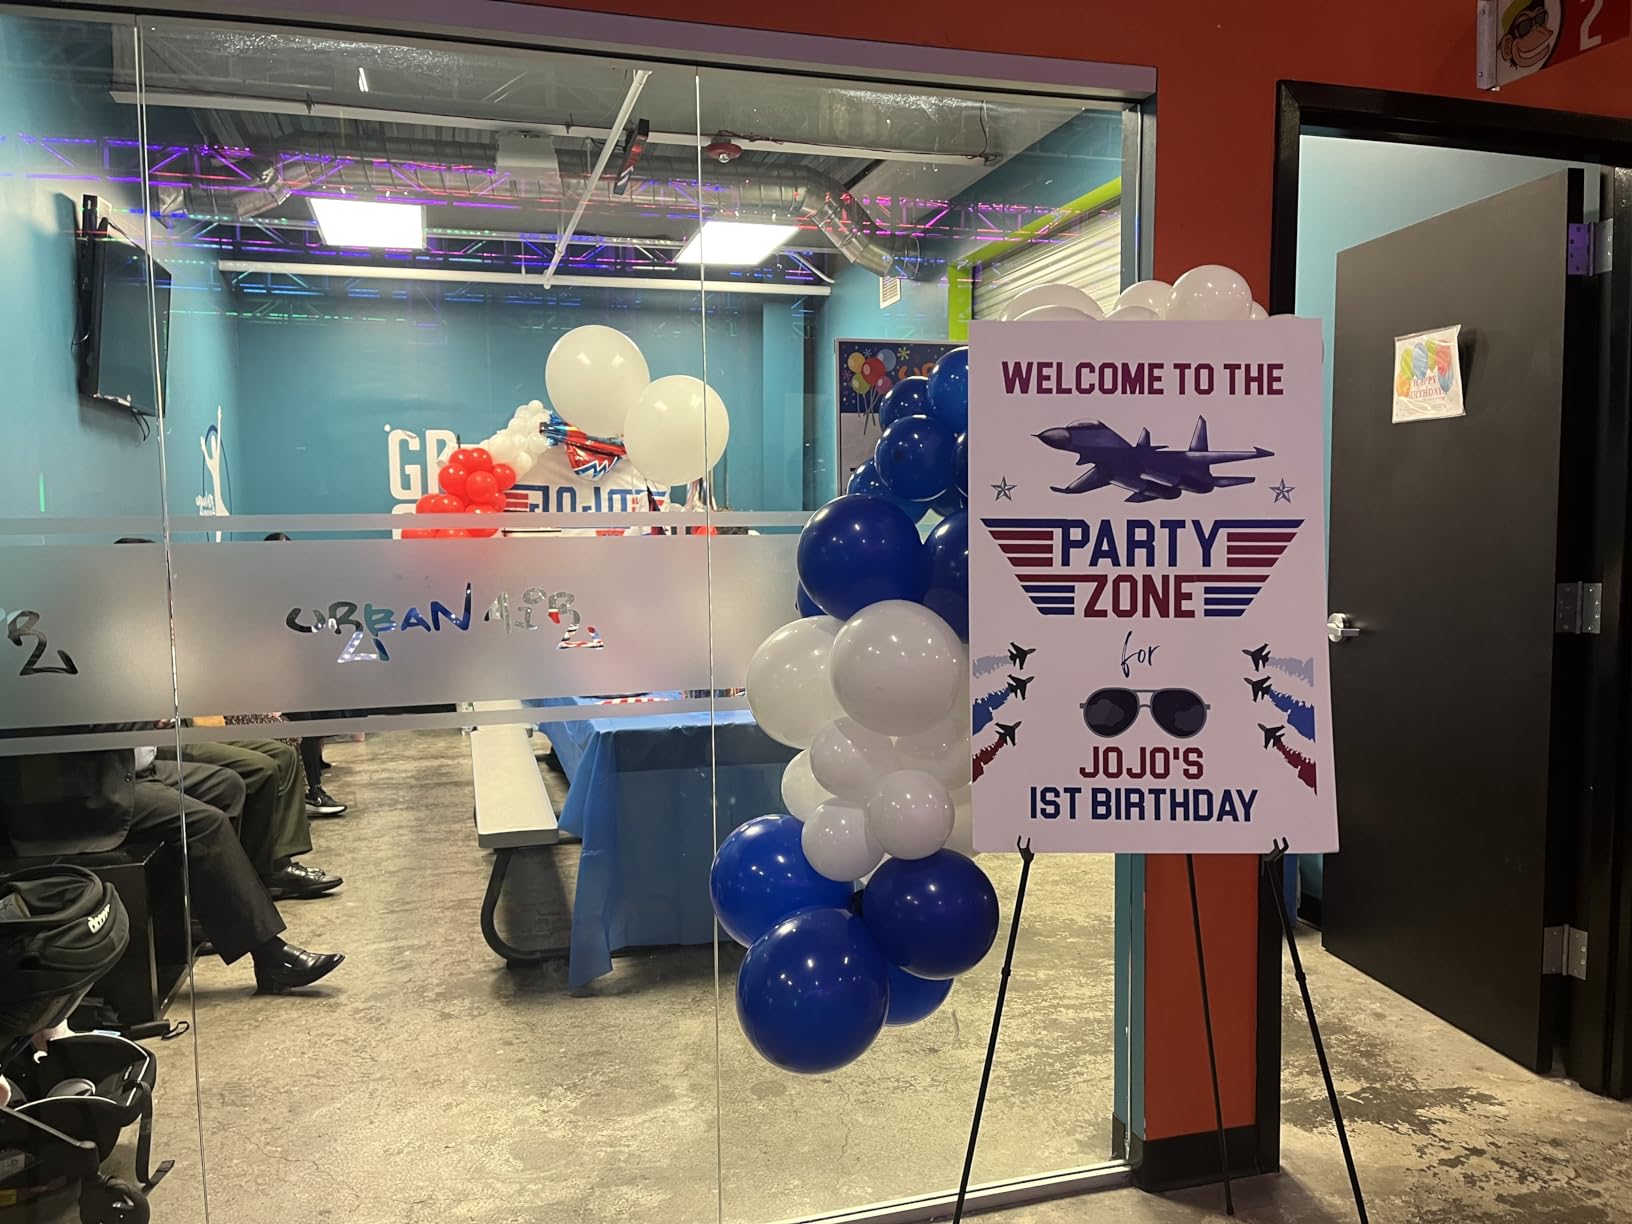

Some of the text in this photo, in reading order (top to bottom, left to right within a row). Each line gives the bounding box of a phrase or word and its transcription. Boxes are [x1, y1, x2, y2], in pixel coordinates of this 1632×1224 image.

[1001, 361, 1284, 396] WELCOME TO THE
[1061, 519, 1221, 567] PARTY
[1083, 574, 1197, 618] ZONE
[285, 582, 472, 664] URBAN
[1120, 630, 1160, 678] for
[1079, 746, 1205, 780] JOJO'S
[1091, 787, 1259, 823] BIRTHDAY
